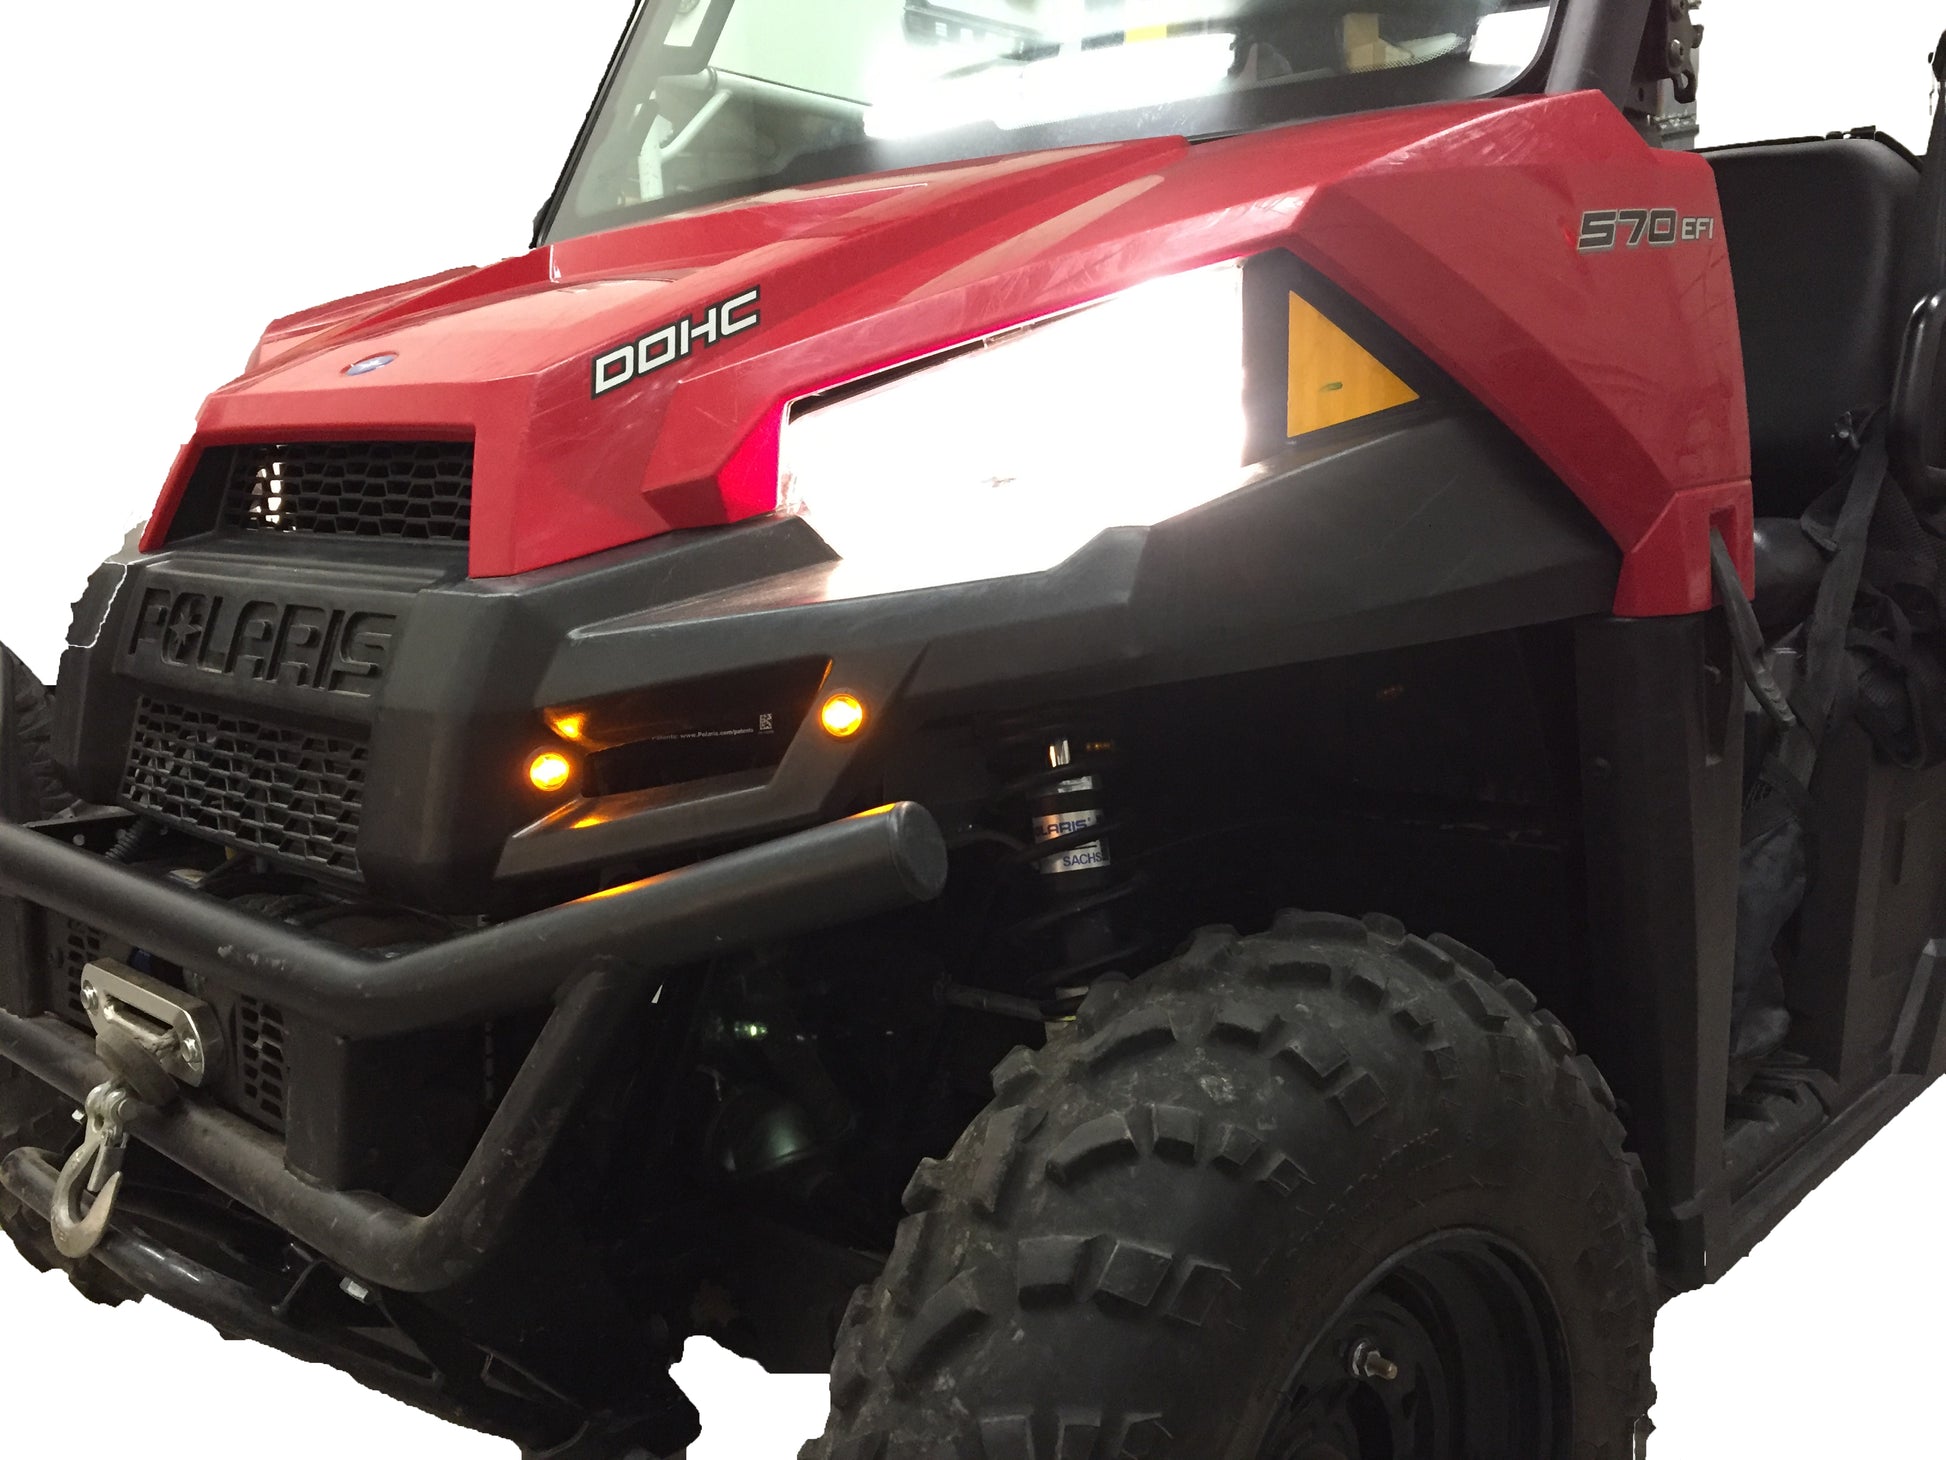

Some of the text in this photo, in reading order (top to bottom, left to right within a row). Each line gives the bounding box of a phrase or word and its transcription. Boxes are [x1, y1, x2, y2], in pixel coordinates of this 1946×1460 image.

[1577, 208, 1714, 252] 570 EFI
[592, 285, 760, 399] DOHC
[127, 587, 397, 698] POLARIS
[1063, 851, 1103, 867] SACHS
